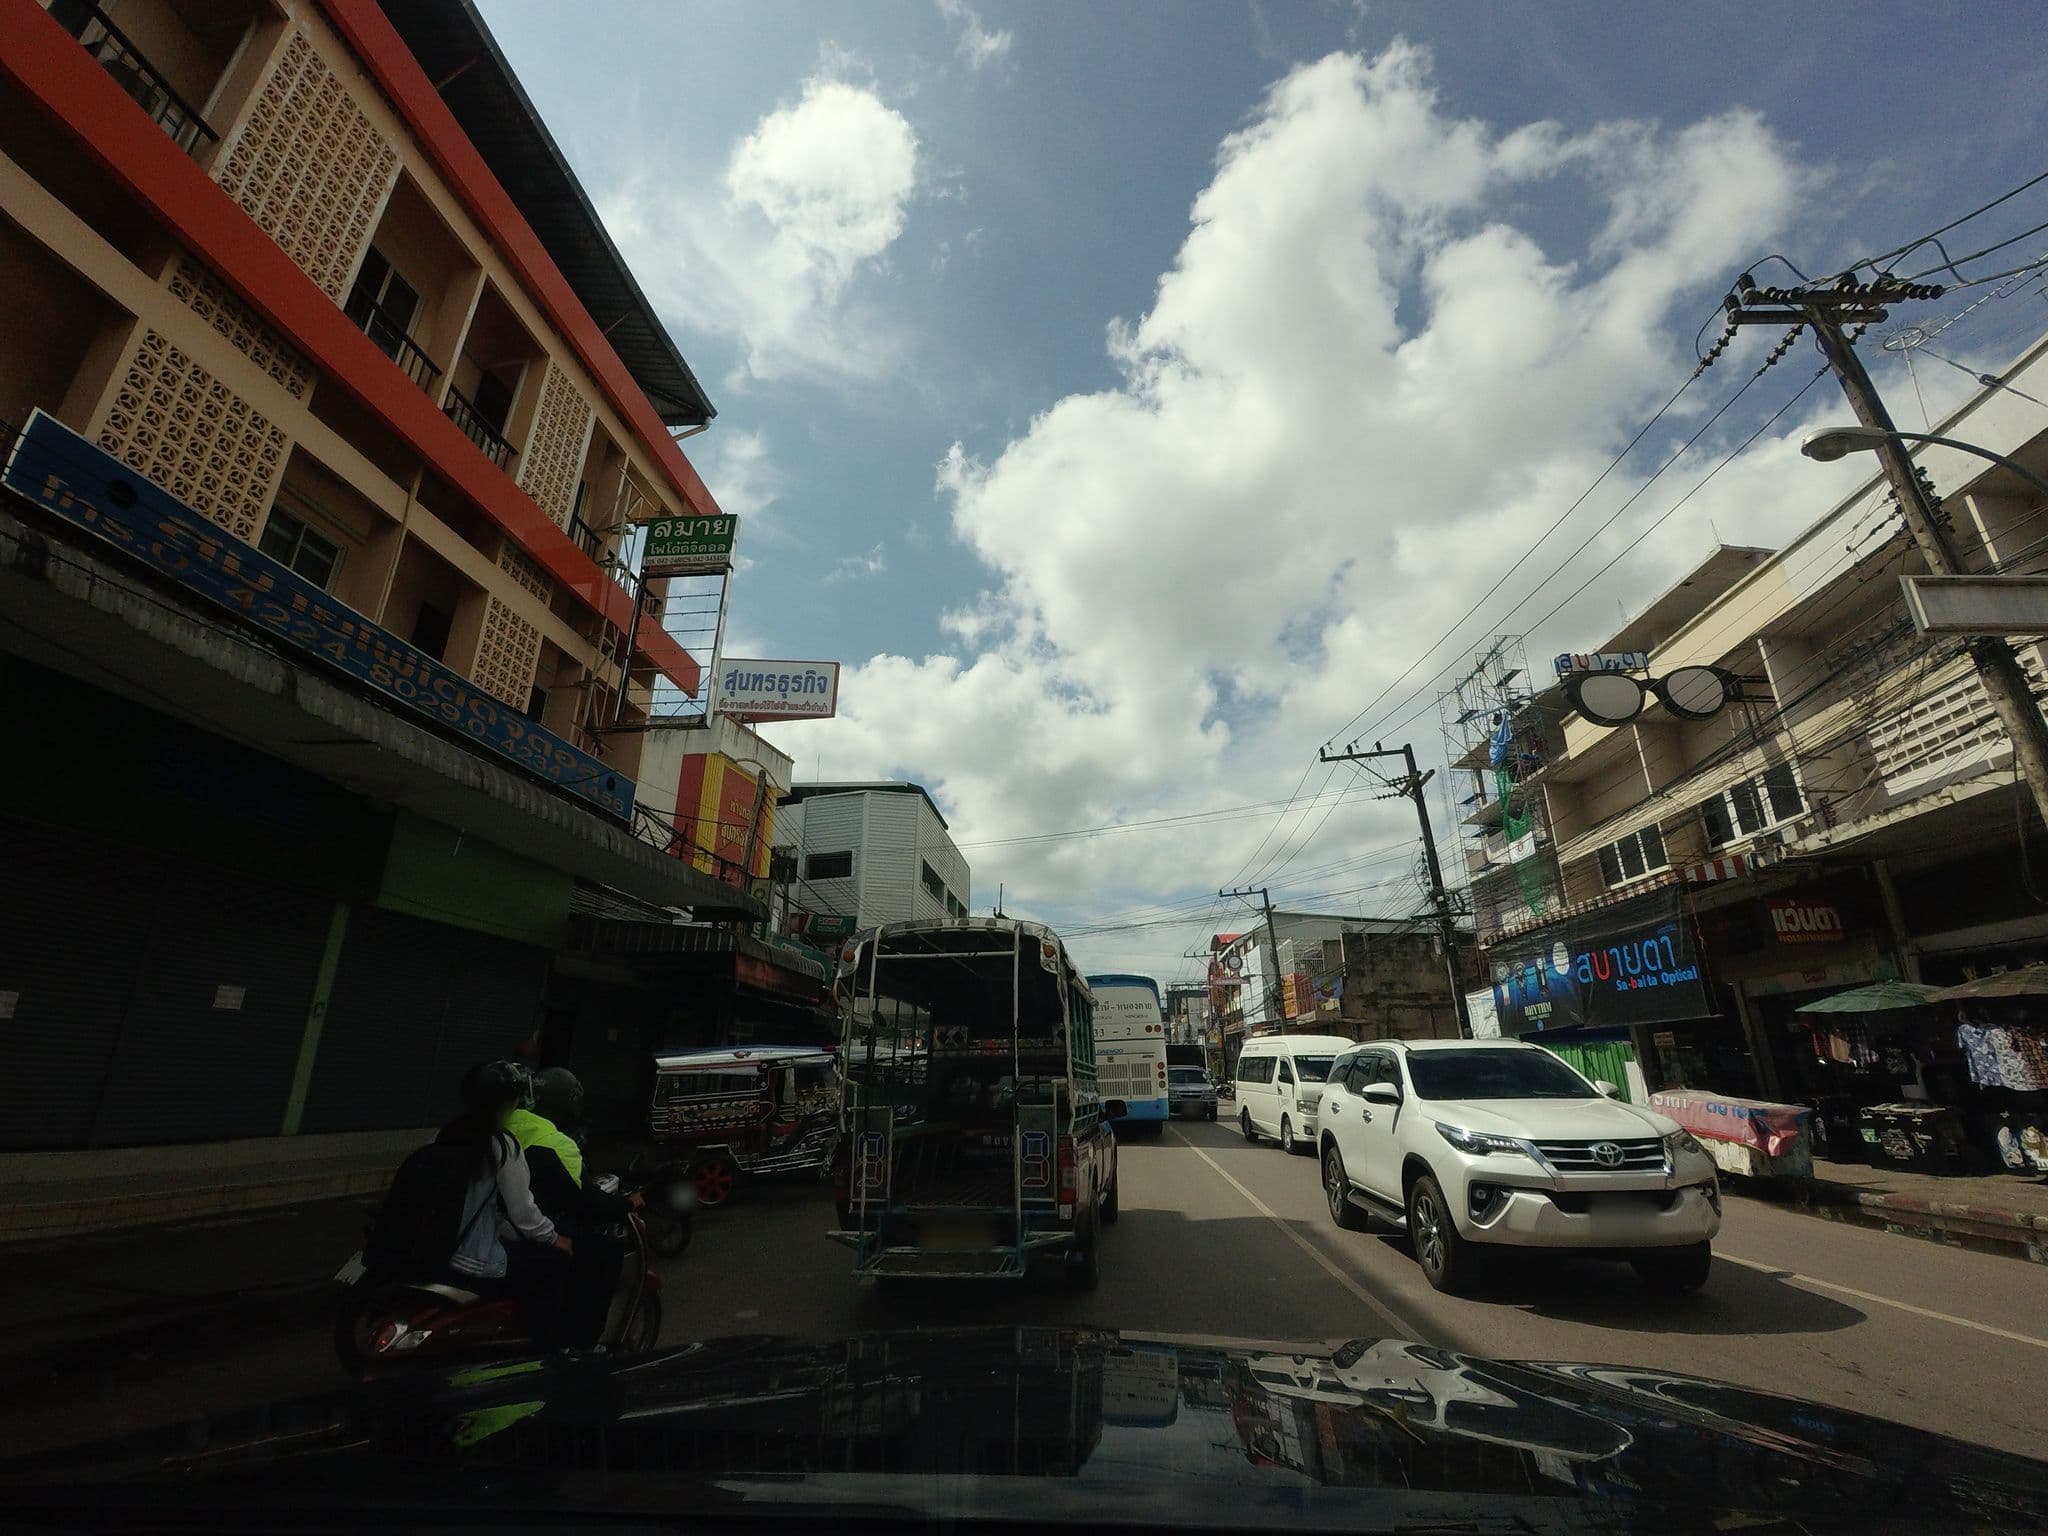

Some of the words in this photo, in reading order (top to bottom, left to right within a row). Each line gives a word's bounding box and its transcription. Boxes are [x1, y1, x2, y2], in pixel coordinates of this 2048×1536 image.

[653, 518, 731, 538] สมาย
[724, 669, 828, 699] สุนทรธุรกิจ
[1770, 898, 1842, 933] แว่นตา
[1576, 934, 1677, 984] สบายตา
[1660, 965, 1698, 986] Optical
[1524, 1001, 1553, 1017] RHYTHM
